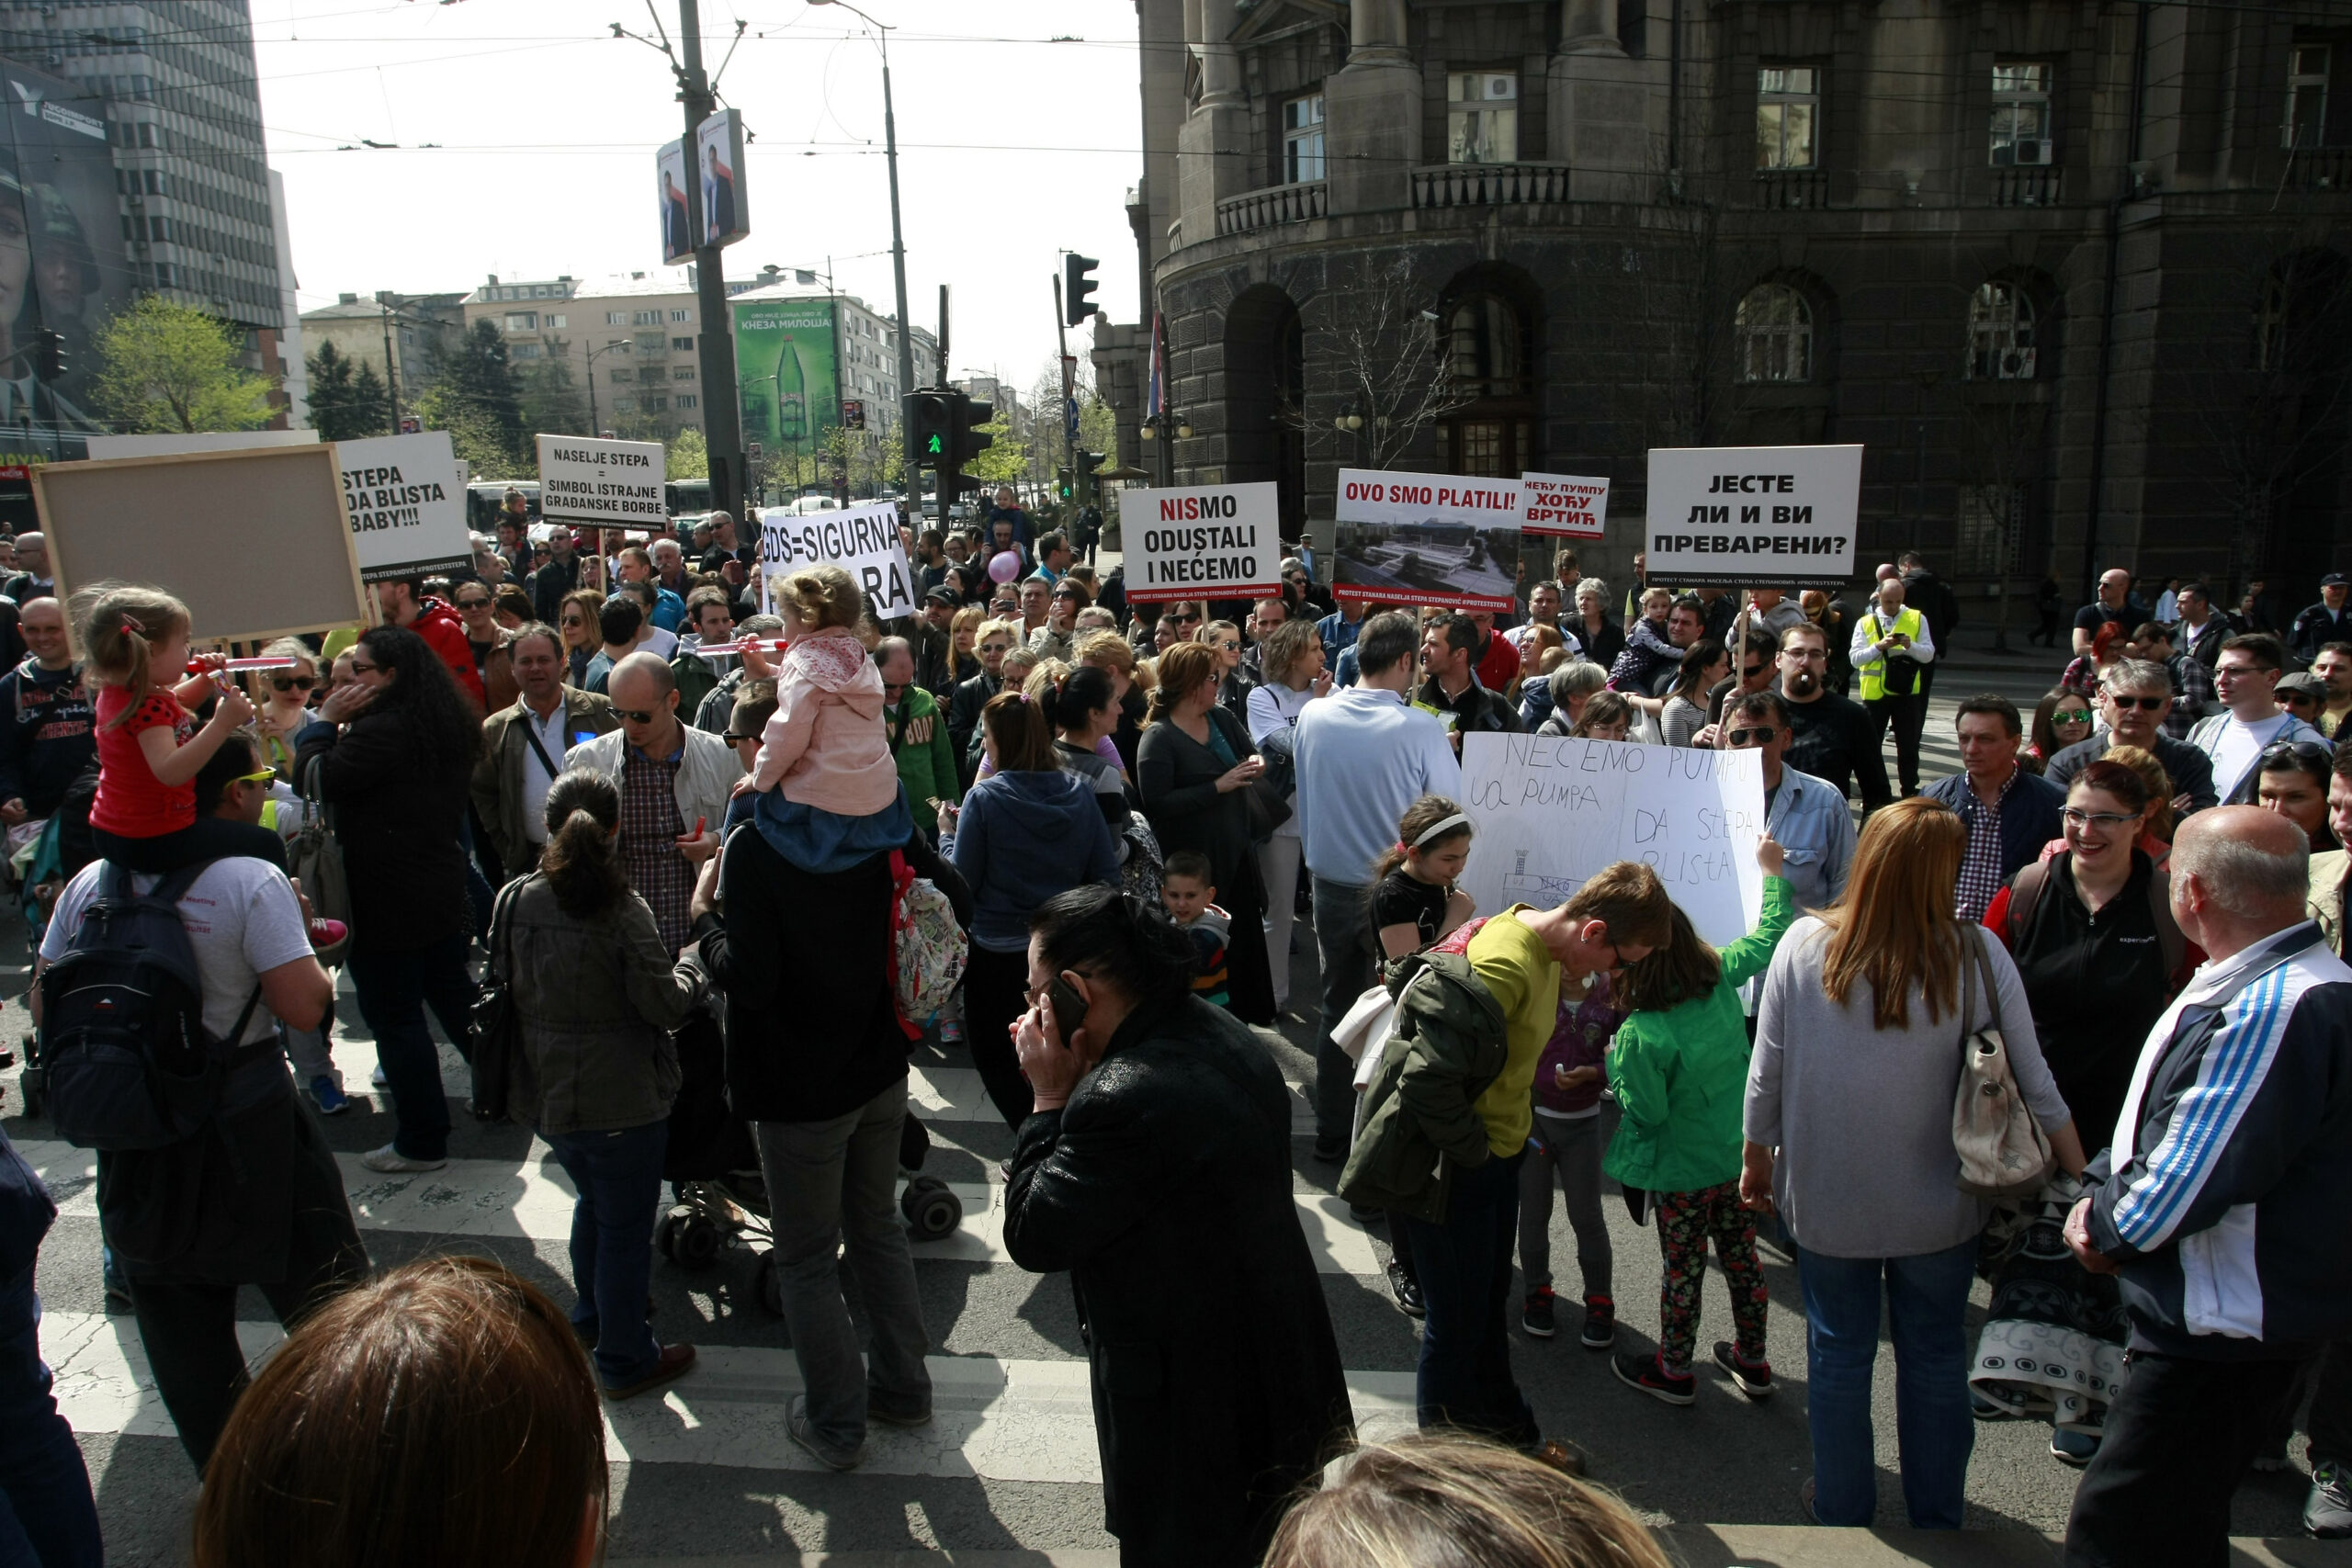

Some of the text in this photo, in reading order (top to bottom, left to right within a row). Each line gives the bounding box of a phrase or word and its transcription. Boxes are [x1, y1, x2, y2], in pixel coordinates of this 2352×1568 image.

[741, 318, 832, 331] КНЕЗА МИЛОША!
[554, 448, 650, 468] NASELJE STEPA
[343, 466, 403, 490] STEPA
[1525, 481, 1606, 495] НЕЋУ ПУМПУ
[1708, 475, 1794, 493] ЈЕСТЕ
[376, 482, 446, 508] BLISTA
[548, 479, 658, 499] SIMBOL ISTRAJNE
[1346, 482, 1517, 511] OVO SMO PLATILI!
[546, 494, 662, 514] GRAĐANSKE BORBE
[1159, 494, 1238, 521] NISMO
[1535, 492, 1591, 509] ХОЋУ
[350, 507, 420, 533] BABY!!!
[1526, 507, 1596, 525] ВРТИЋ
[1687, 505, 1813, 524] ЛИ И ВИ
[763, 513, 902, 564] GDS=SIGURNA
[1145, 525, 1256, 553] ODUSTALI
[1655, 535, 1848, 555] ПРЕВАРЕНИ?
[379, 566, 416, 579] STEPANOVIĆ
[417, 560, 468, 572] #PROTESTSTEPA
[1148, 551, 1257, 583] I NEĆEMO
[1339, 589, 1362, 597] PROTEST
[1362, 591, 1385, 599] STANARA
[1429, 596, 1461, 604] STEPANOVIĆ
[1462, 599, 1508, 608] #PROTESTSTEPA
[1668, 747, 1748, 782] PUMPU
[1521, 778, 1602, 811] PUMPA
[1635, 807, 1669, 843] DA
[186, 896, 217, 906] Meeting
